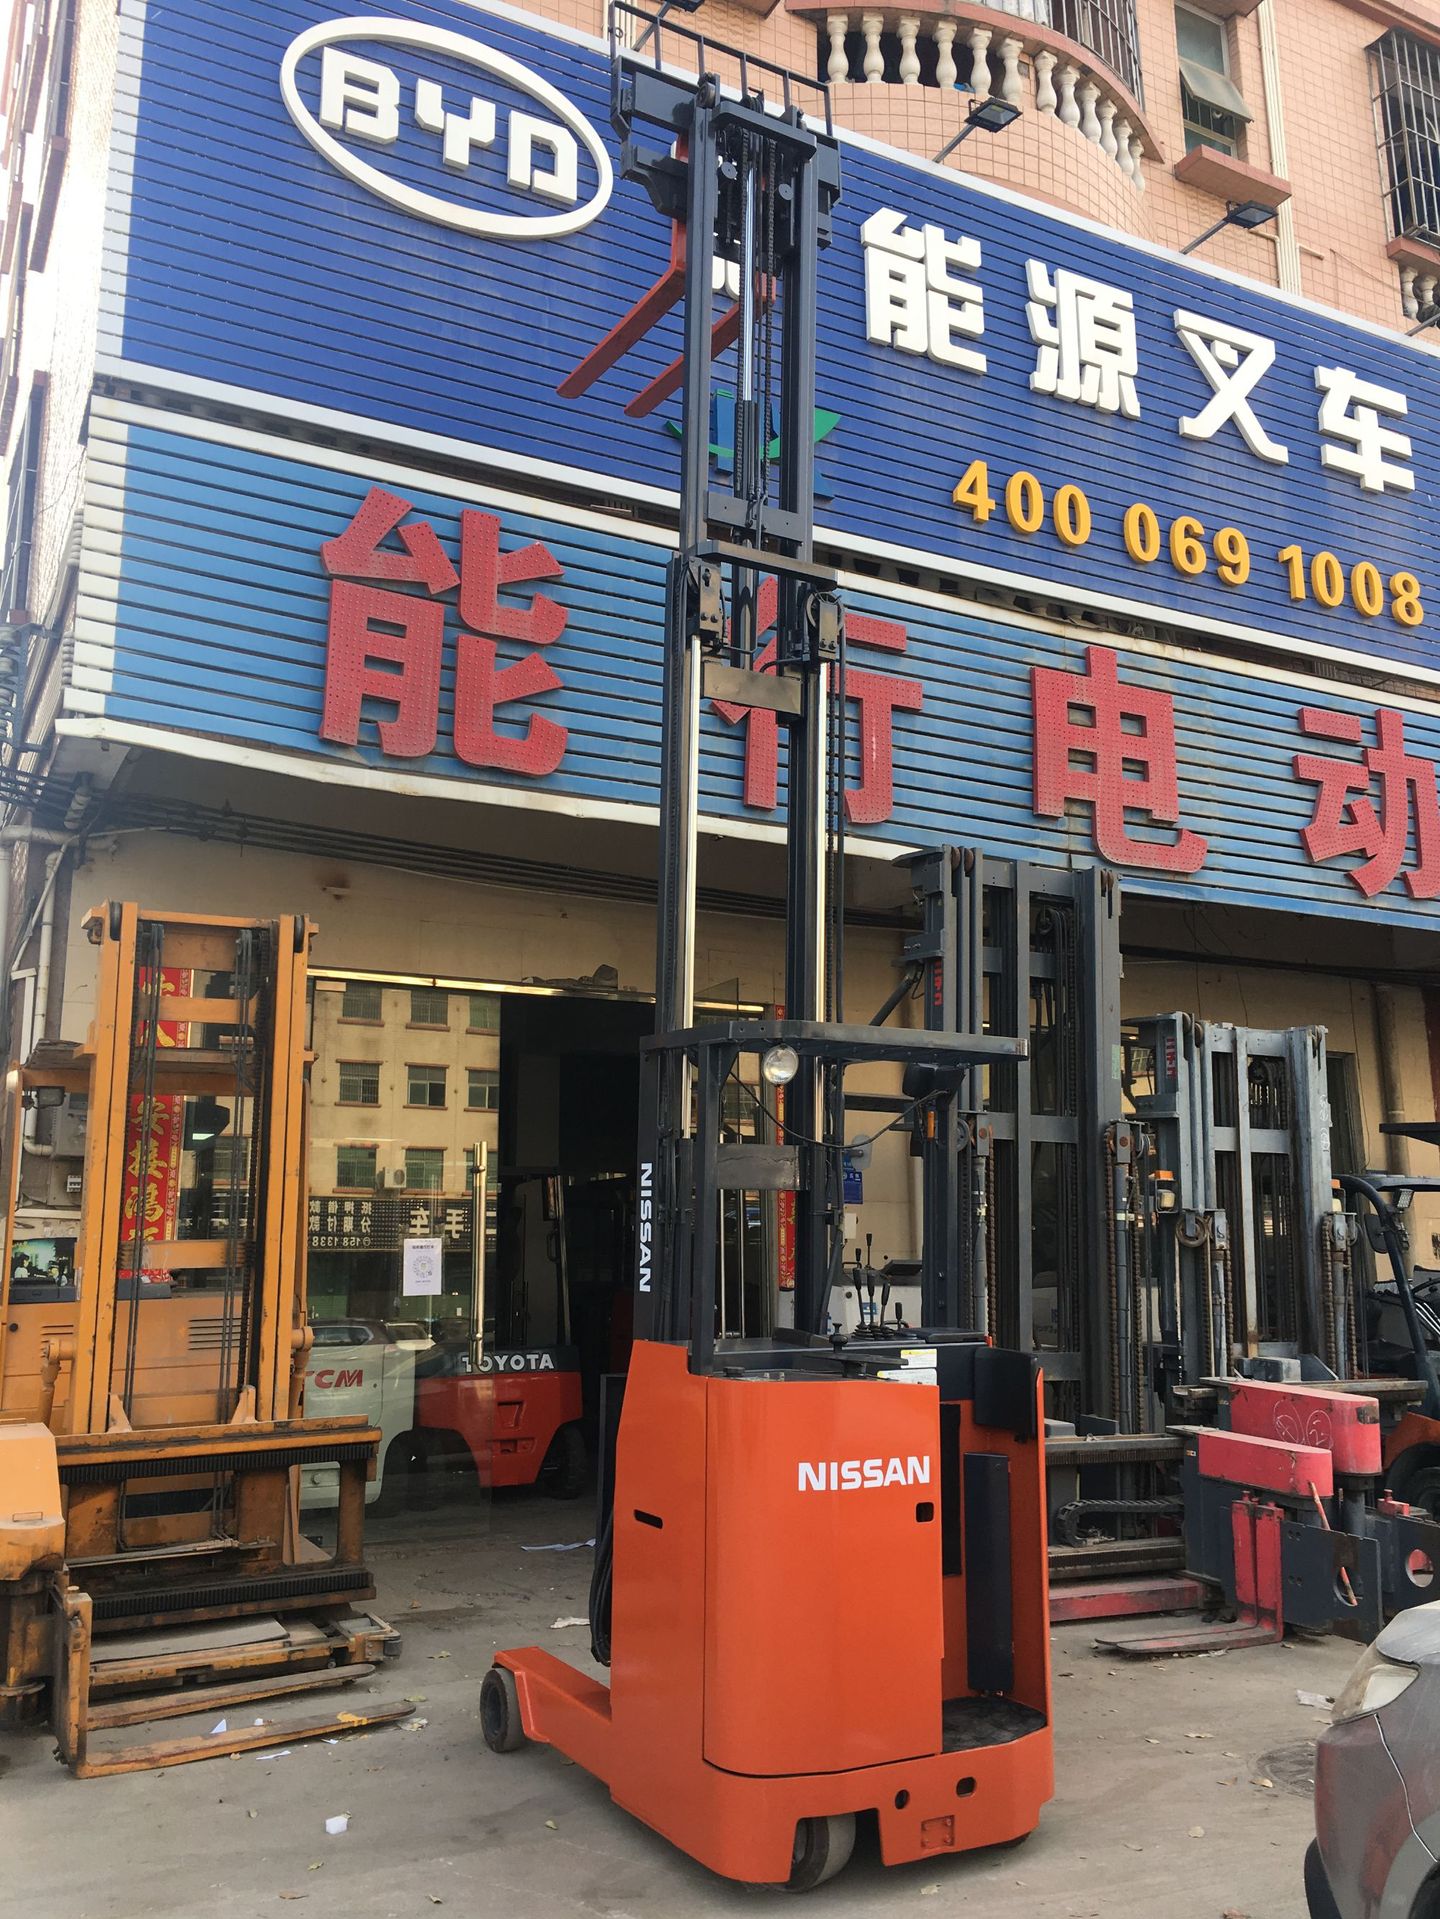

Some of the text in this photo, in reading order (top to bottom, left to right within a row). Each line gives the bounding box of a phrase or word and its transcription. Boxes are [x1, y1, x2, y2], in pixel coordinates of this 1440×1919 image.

[319, 46, 578, 205] BYD
[712, 207, 1415, 493] 能源叉车
[953, 459, 1424, 627] 400 069 1008
[639, 1162, 653, 1293] NISSAN
[462, 1353, 555, 1373] TOYOTA
[798, 1455, 930, 1491] NISSAN
